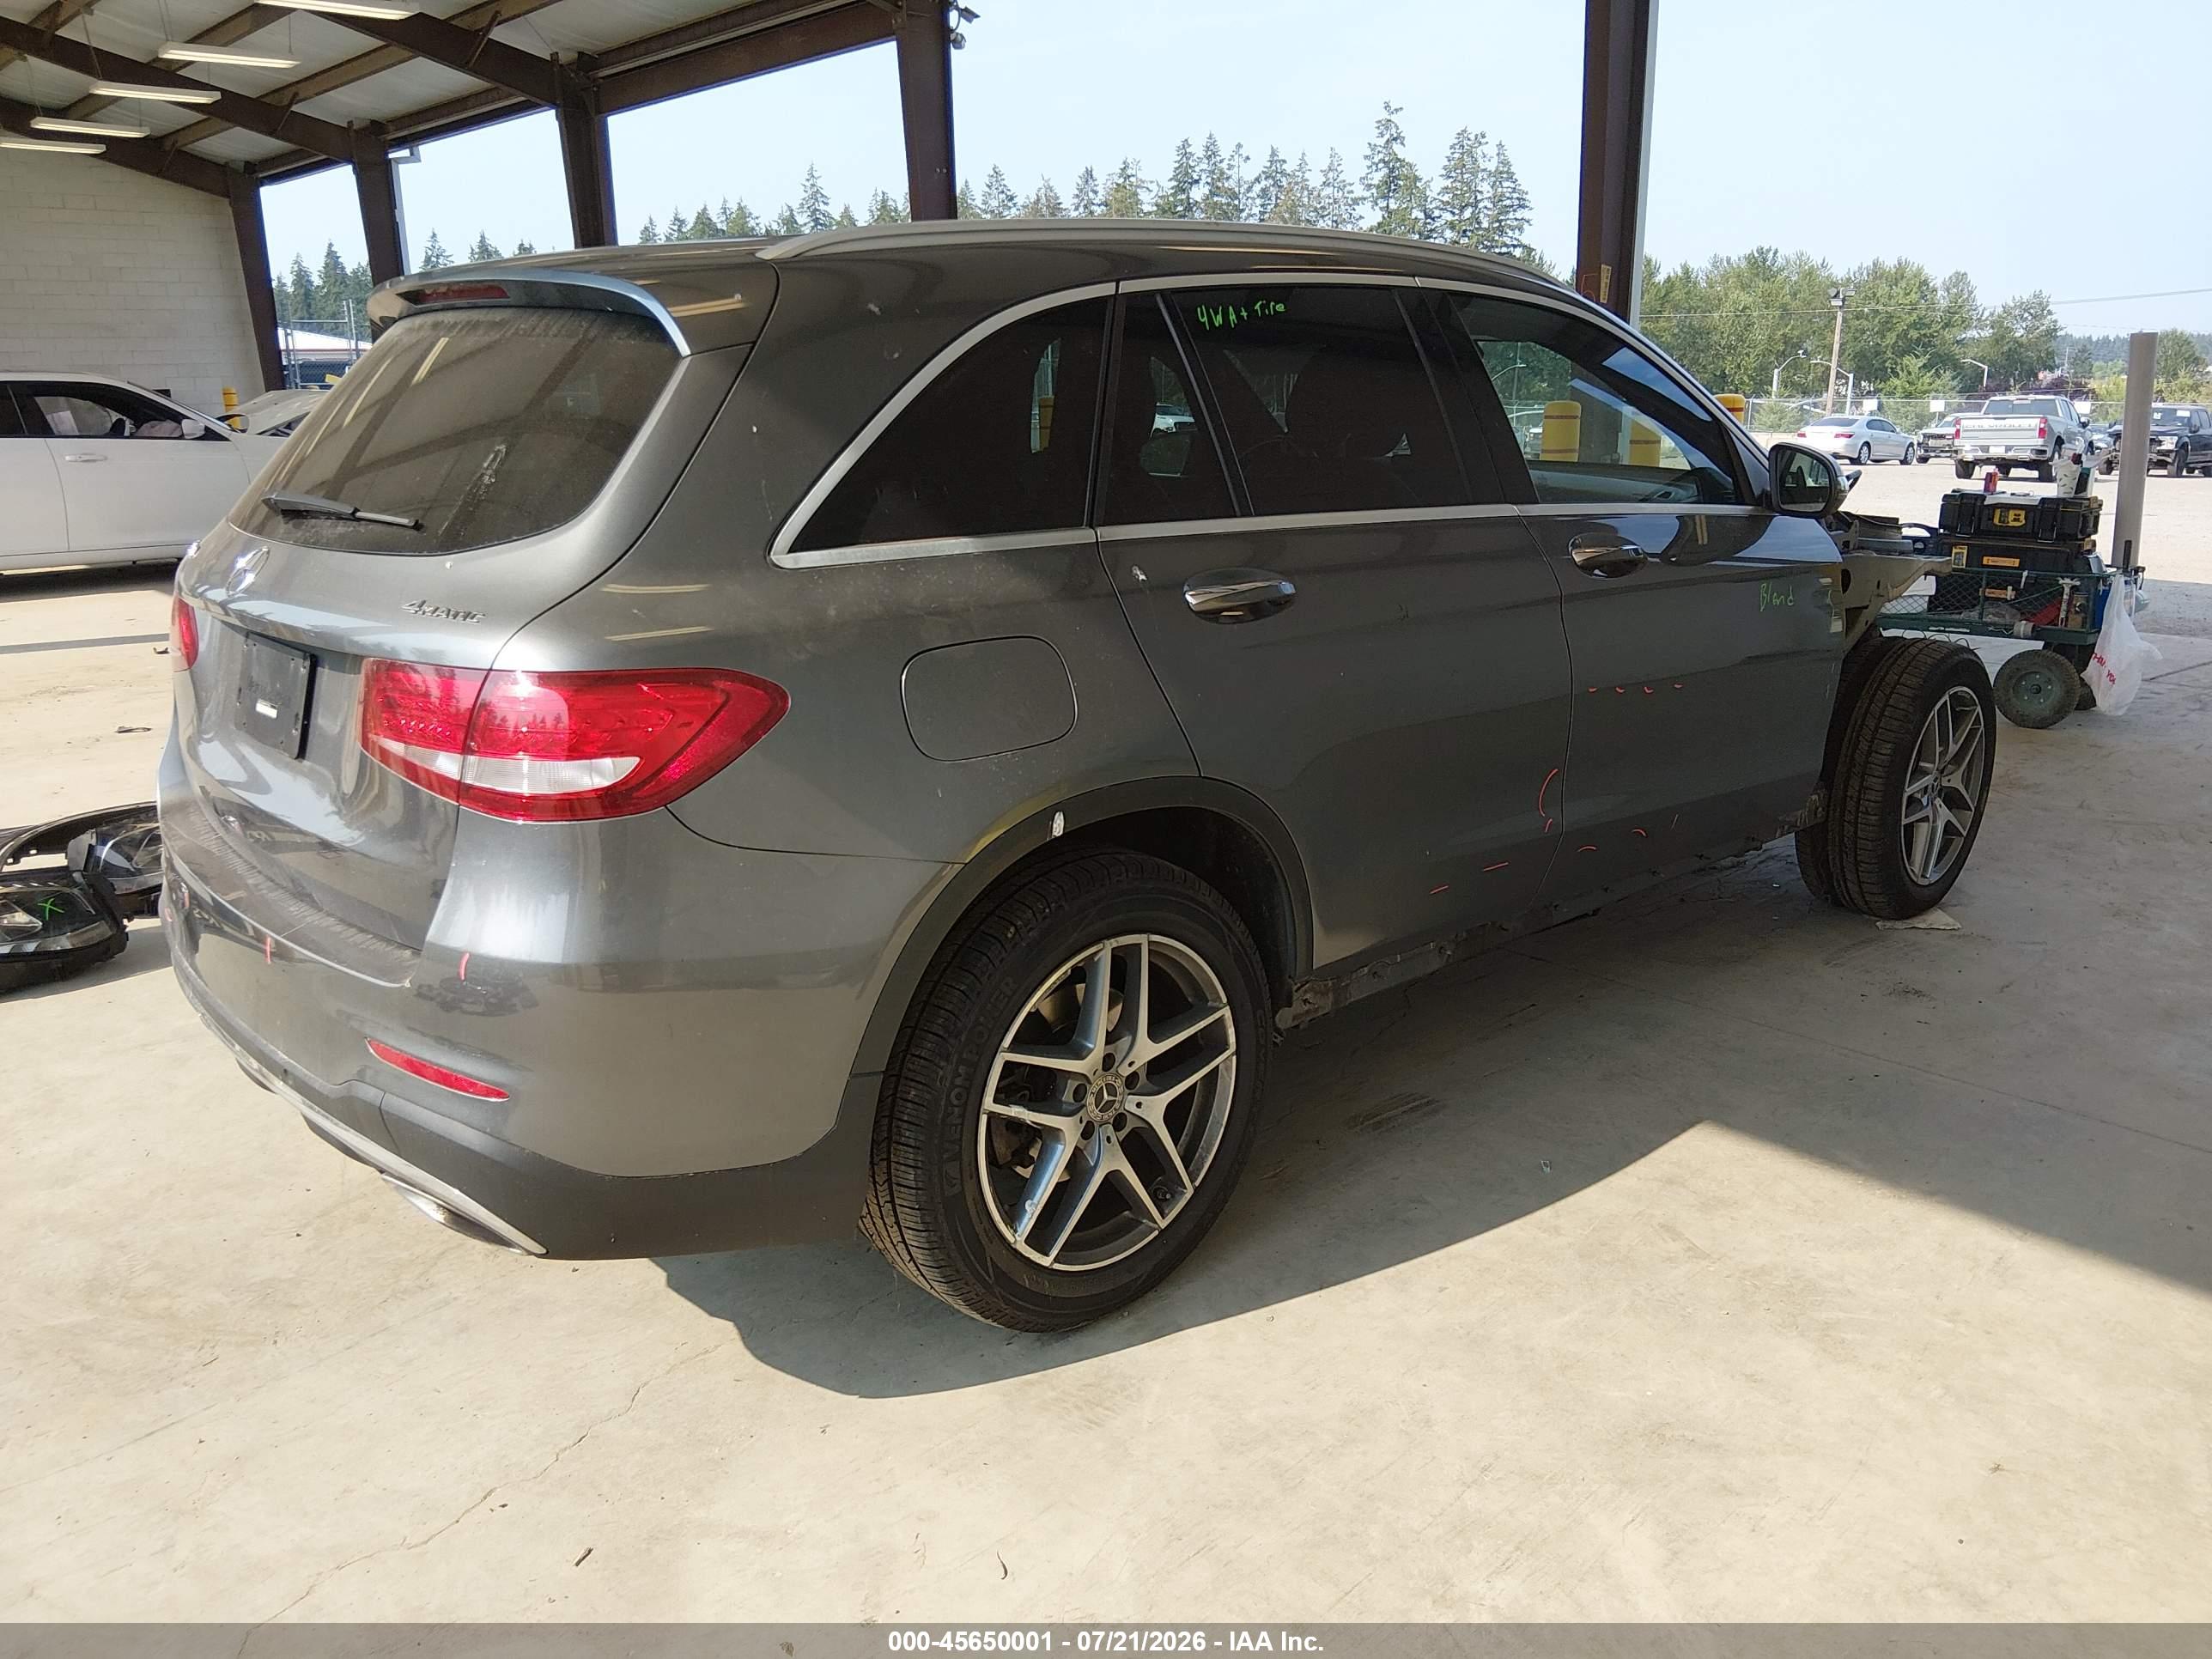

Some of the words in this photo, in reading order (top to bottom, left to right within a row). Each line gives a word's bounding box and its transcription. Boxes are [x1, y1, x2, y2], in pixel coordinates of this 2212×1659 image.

[1254, 300, 1285, 317] Tire
[400, 599, 487, 624] 4MATIC
[943, 1066, 970, 1160] VENOM
